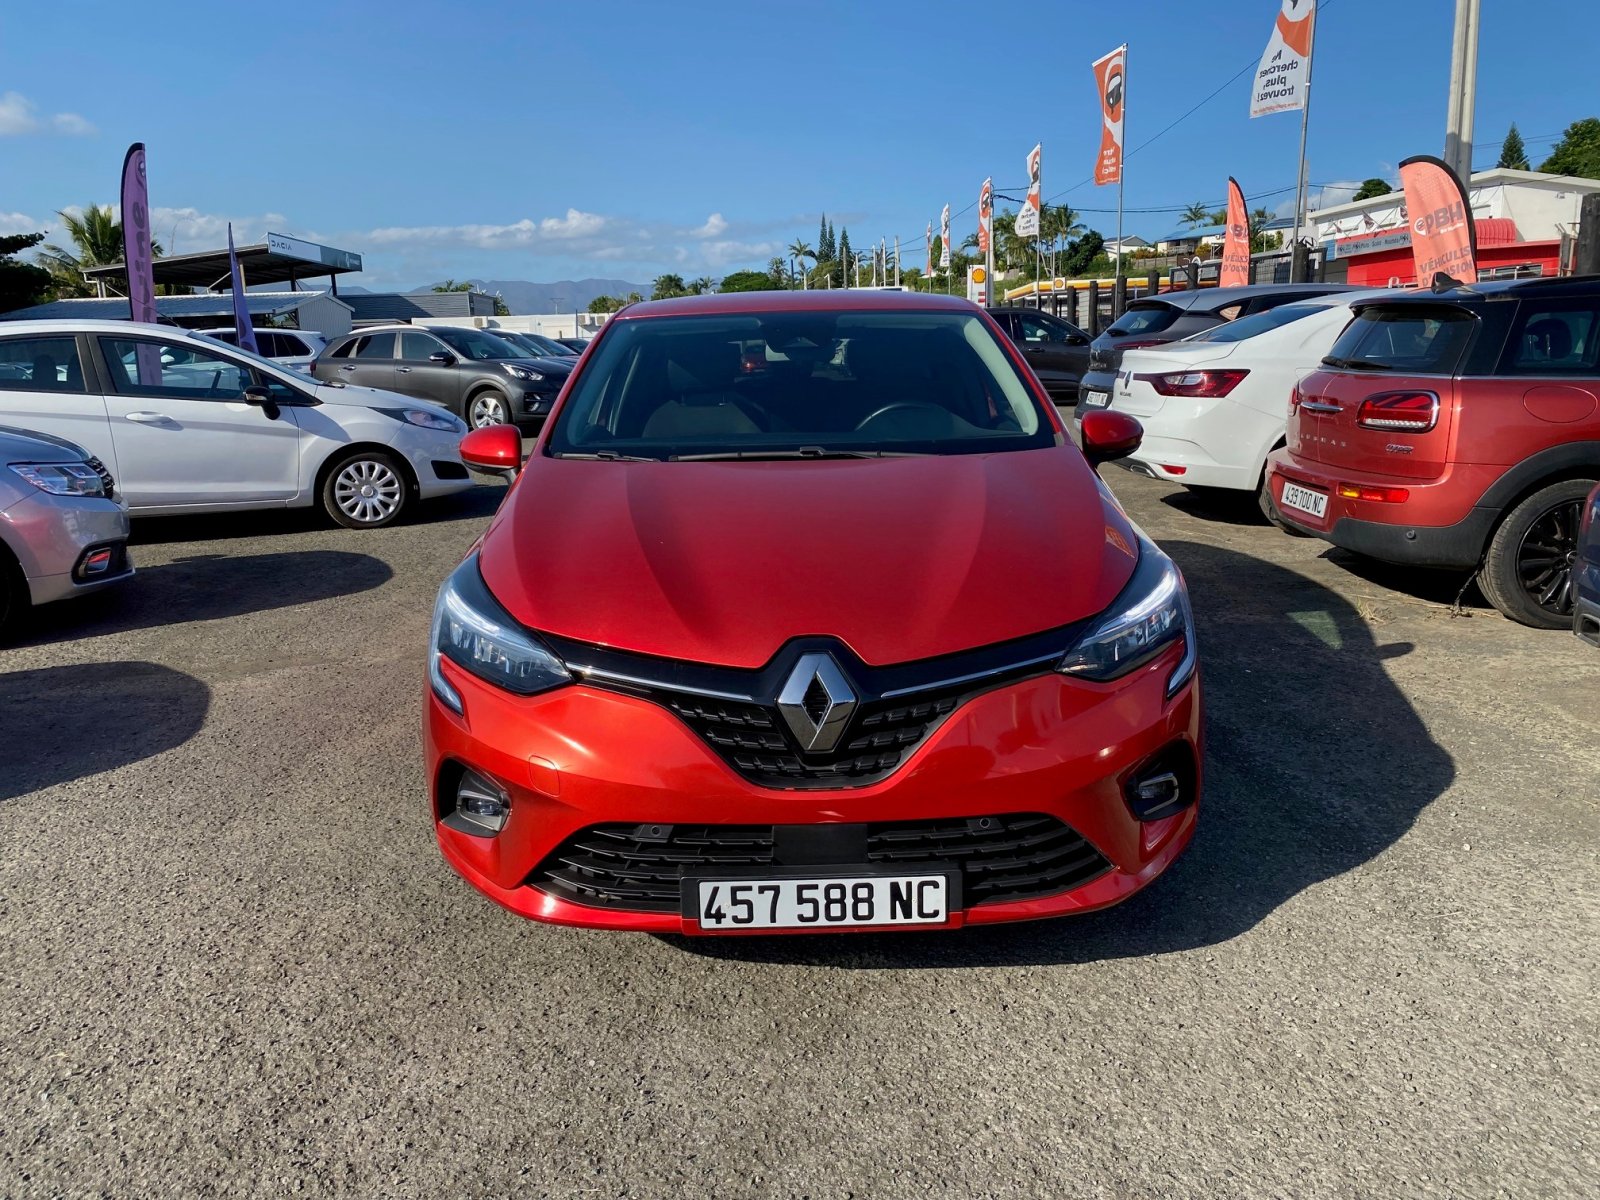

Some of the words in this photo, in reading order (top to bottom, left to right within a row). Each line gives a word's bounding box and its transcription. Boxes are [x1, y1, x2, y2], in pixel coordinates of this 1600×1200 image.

[271, 239, 292, 250] DACIA
[1285, 486, 1298, 505] 439
[1299, 490, 1311, 509] 700
[1312, 494, 1324, 514] NC
[704, 885, 780, 924] 457
[796, 882, 875, 922] 588
[890, 880, 940, 920] NC
